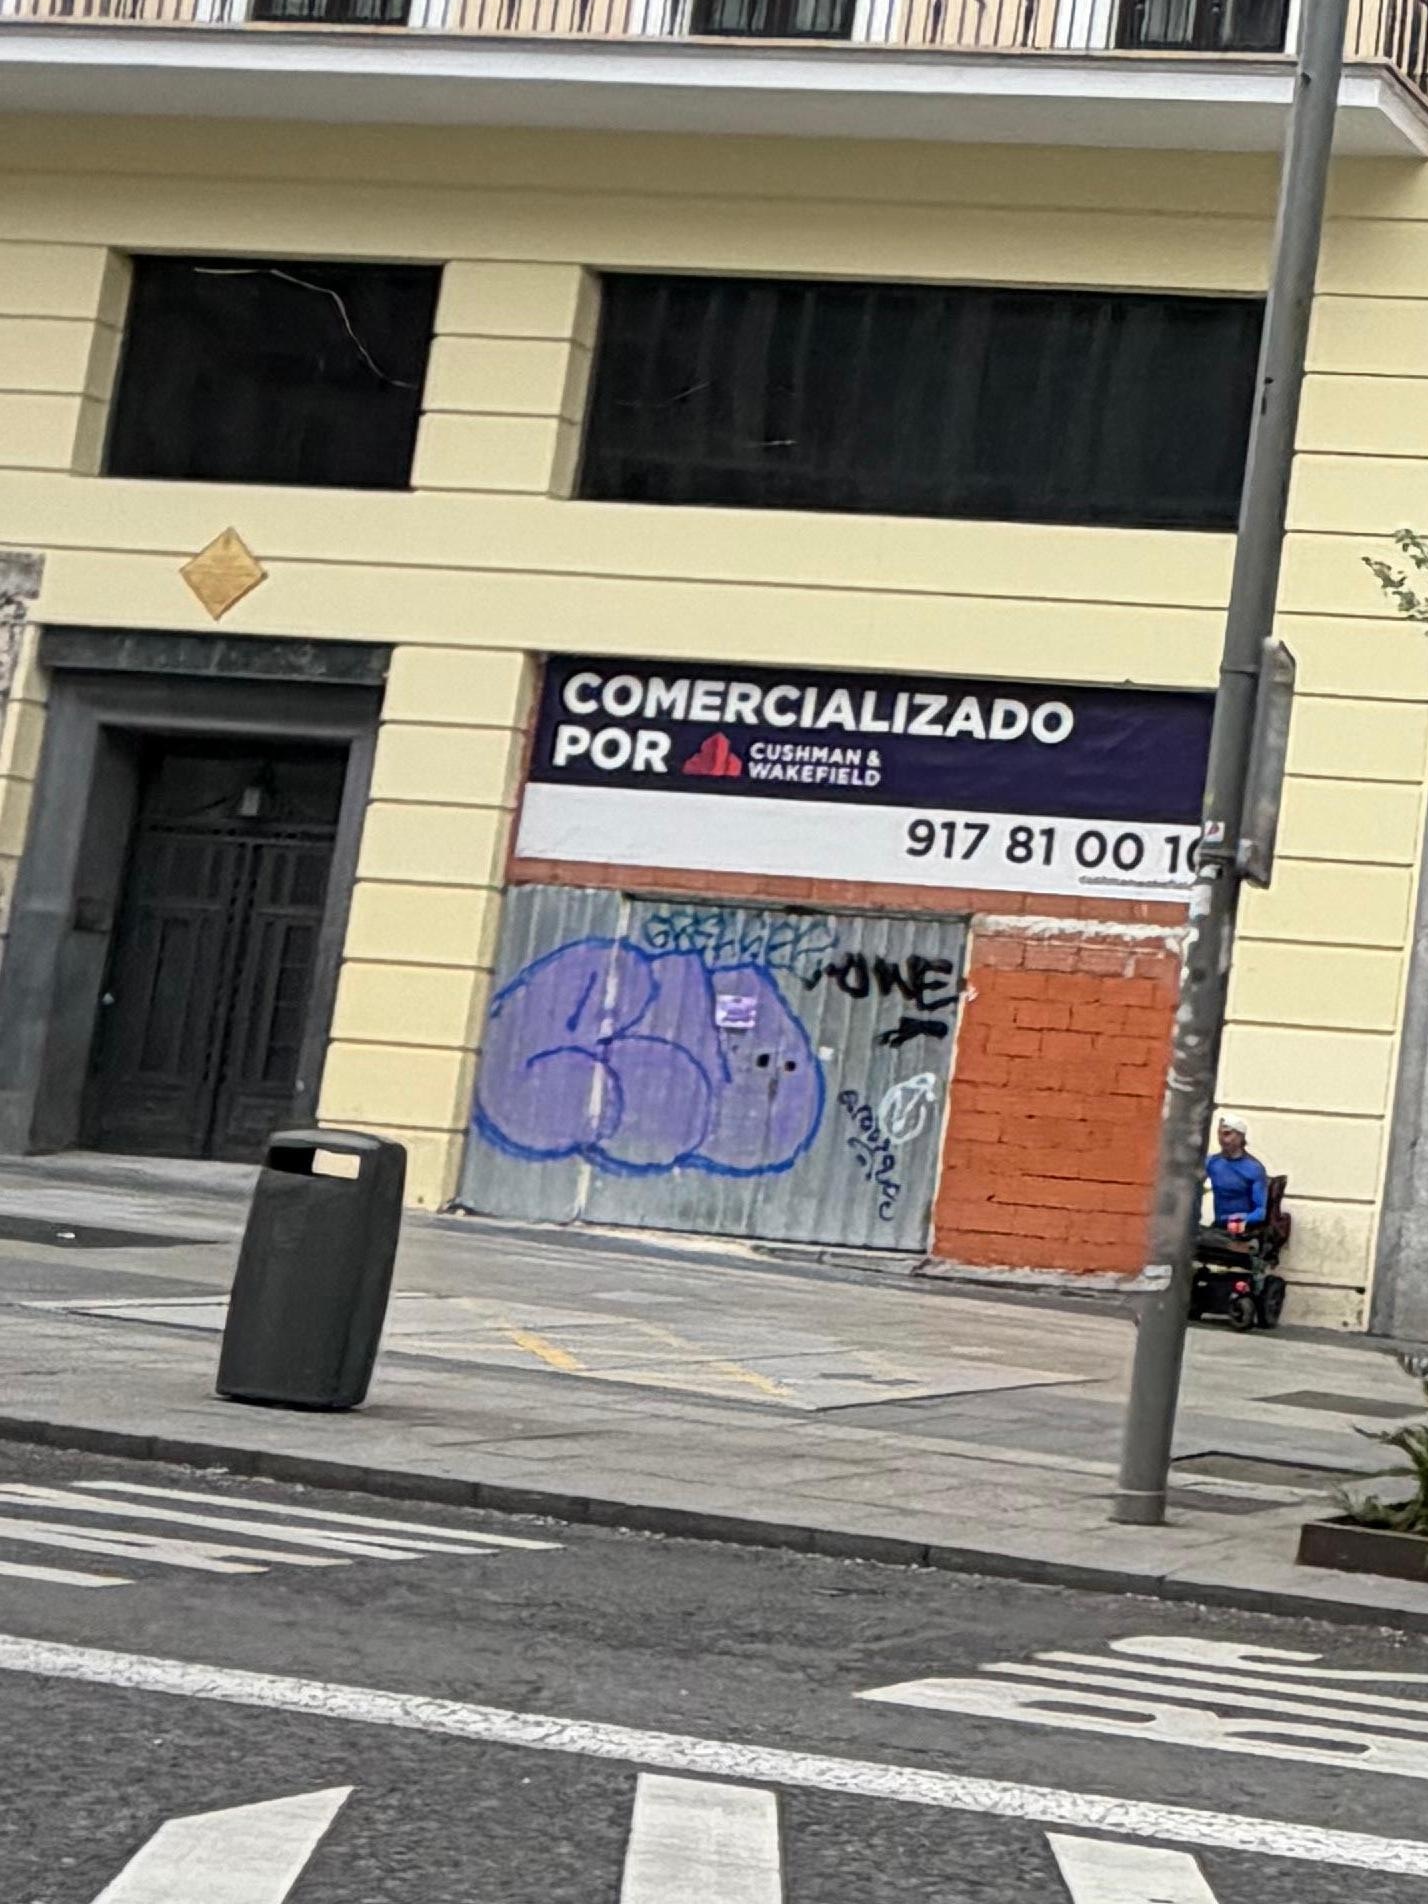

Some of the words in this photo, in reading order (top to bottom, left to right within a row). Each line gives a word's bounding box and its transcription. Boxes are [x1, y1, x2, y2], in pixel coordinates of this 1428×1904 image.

[561, 671, 1074, 745] COMERCIALIZADO
[552, 725, 672, 775] POR
[748, 761, 882, 787] WAKEFIELD
[749, 742, 861, 767] CUSHMAN
[866, 749, 882, 768] &
[905, 818, 990, 862] 917
[1005, 824, 1054, 867] 81
[1073, 828, 1146, 873] 00
